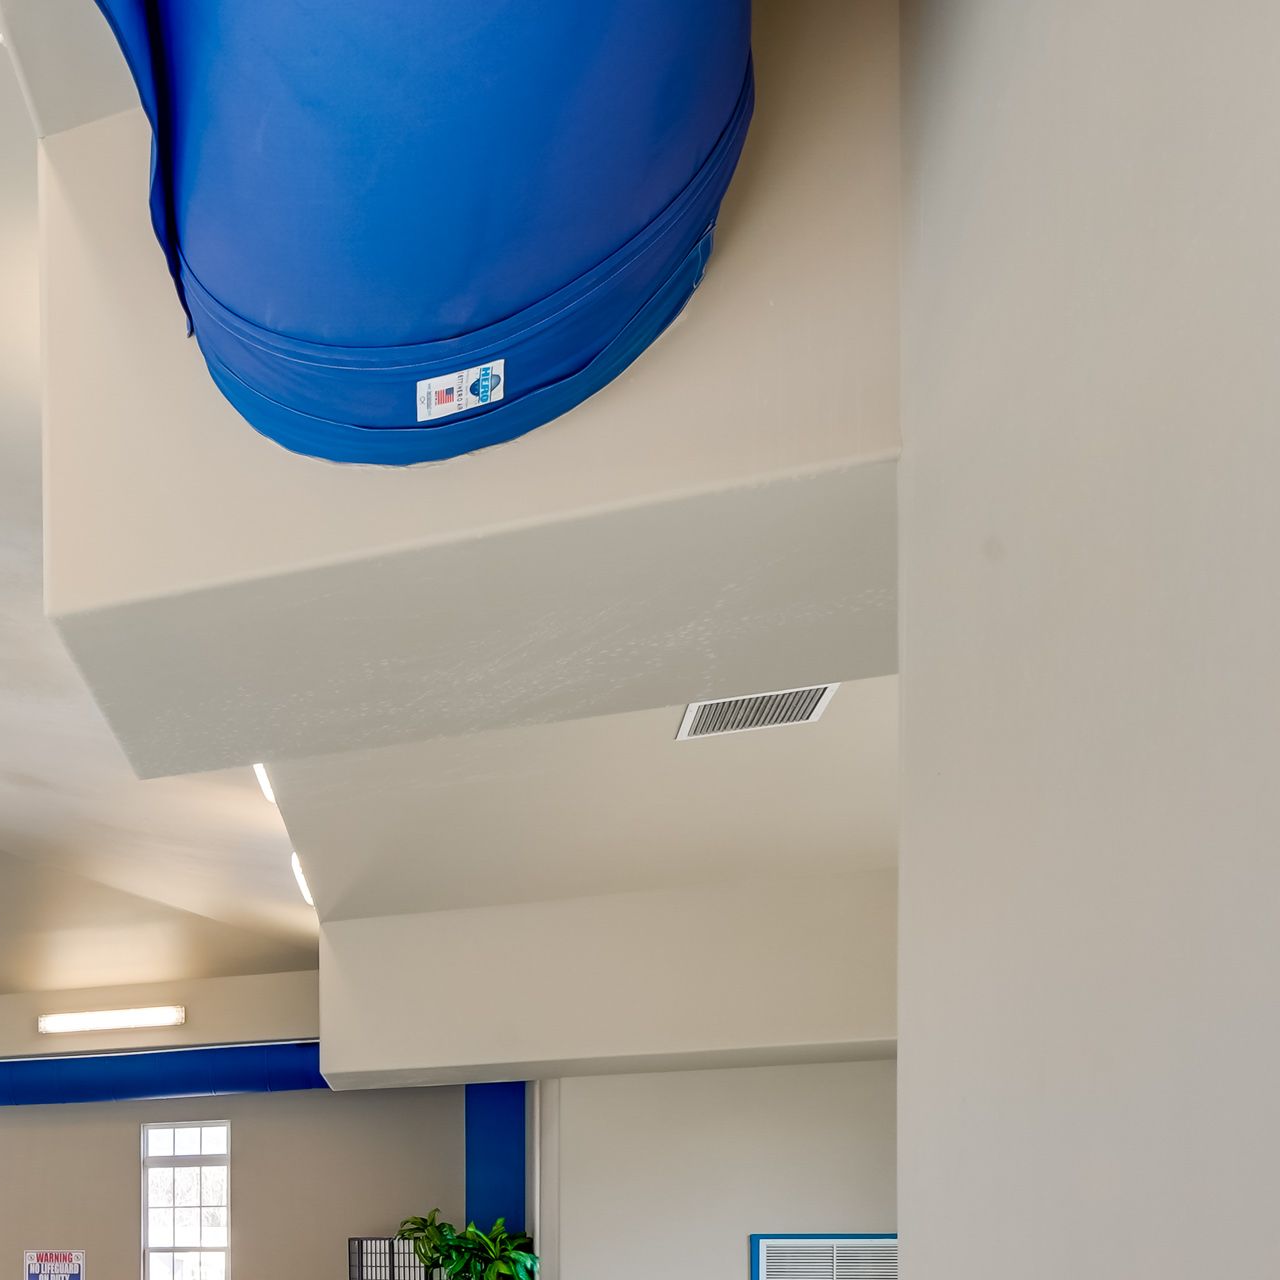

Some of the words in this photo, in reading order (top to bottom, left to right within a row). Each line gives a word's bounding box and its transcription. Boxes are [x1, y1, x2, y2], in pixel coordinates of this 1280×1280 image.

[480, 366, 491, 403] HERO
[35, 1252, 73, 1263] WARNING
[29, 1263, 40, 1274] NO
[40, 1263, 80, 1274] LIFEGUARD
